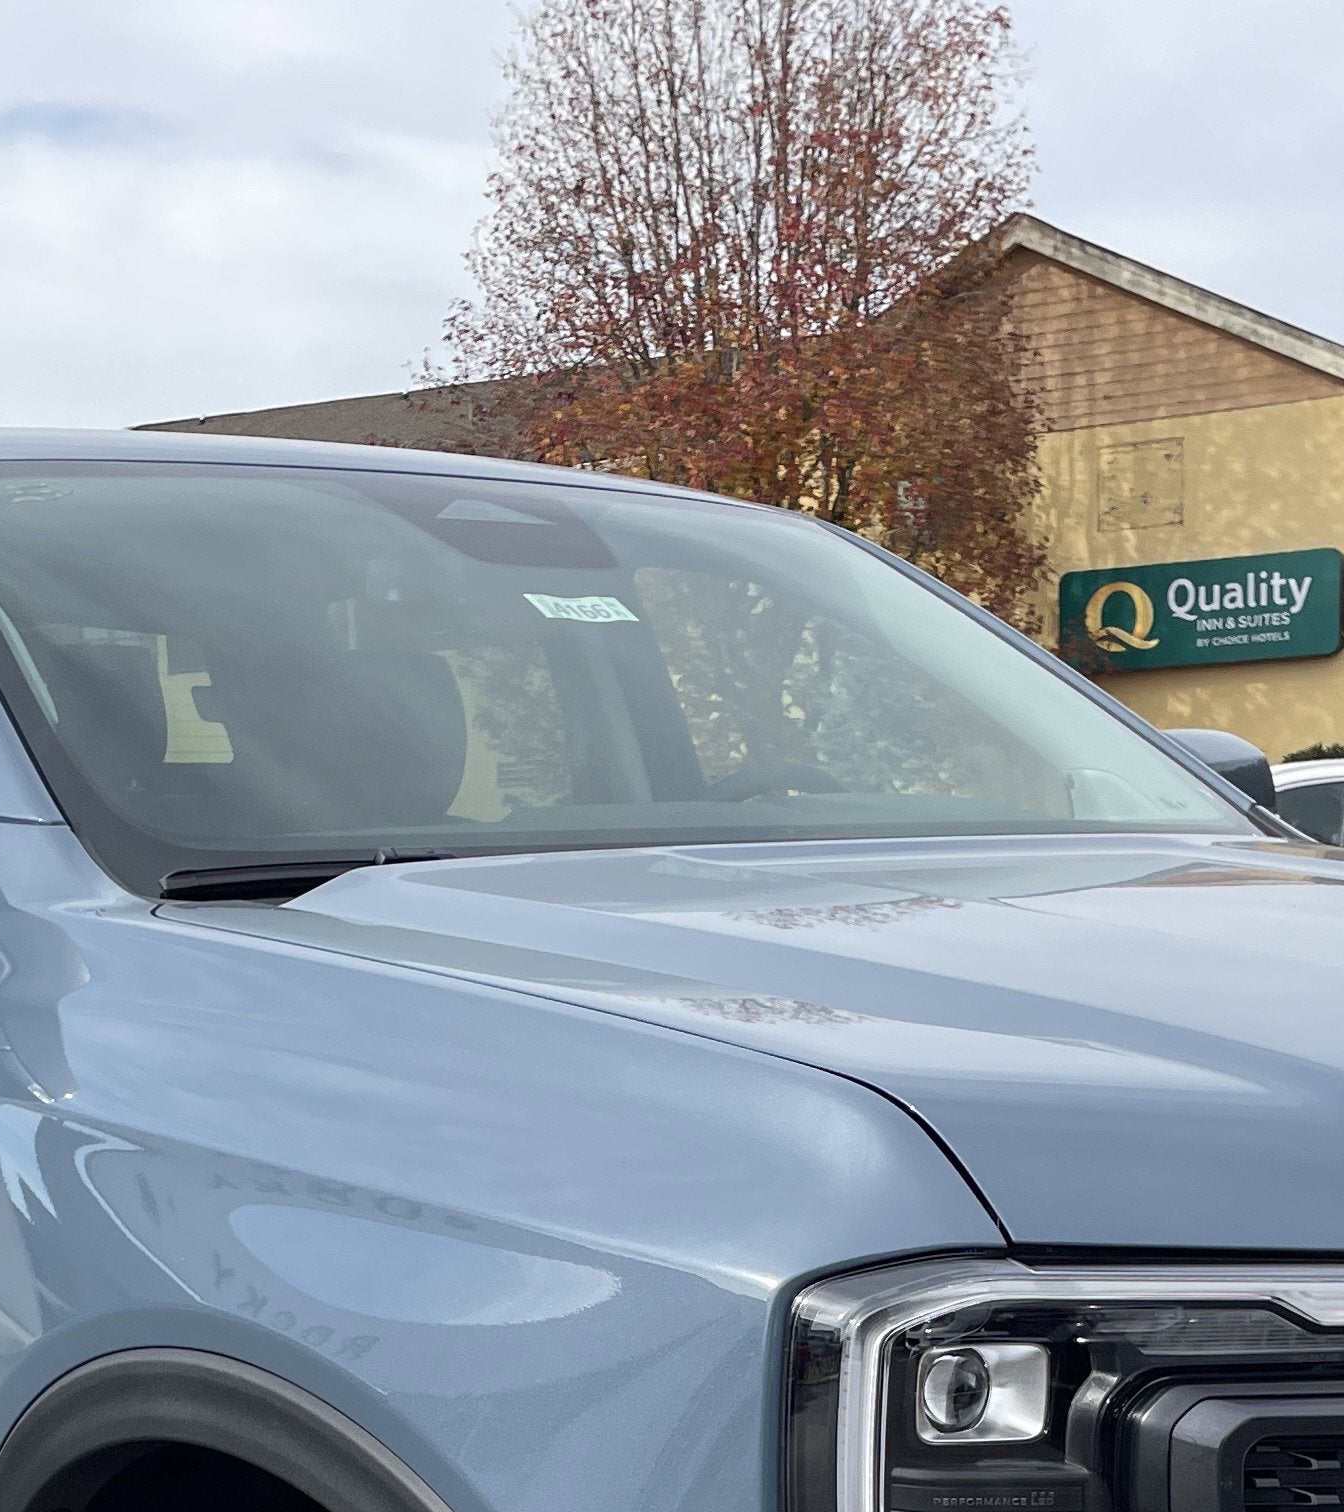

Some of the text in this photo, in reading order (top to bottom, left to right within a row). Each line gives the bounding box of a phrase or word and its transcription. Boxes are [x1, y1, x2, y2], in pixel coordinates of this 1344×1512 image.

[1167, 570, 1313, 621] Quality
[1084, 581, 1160, 652] Q
[1196, 611, 1292, 632] INN & SUITES
[1196, 637, 1211, 648] BY
[1250, 631, 1291, 643] HOTELS
[932, 1496, 1056, 1507] PERFORMANCE LED
